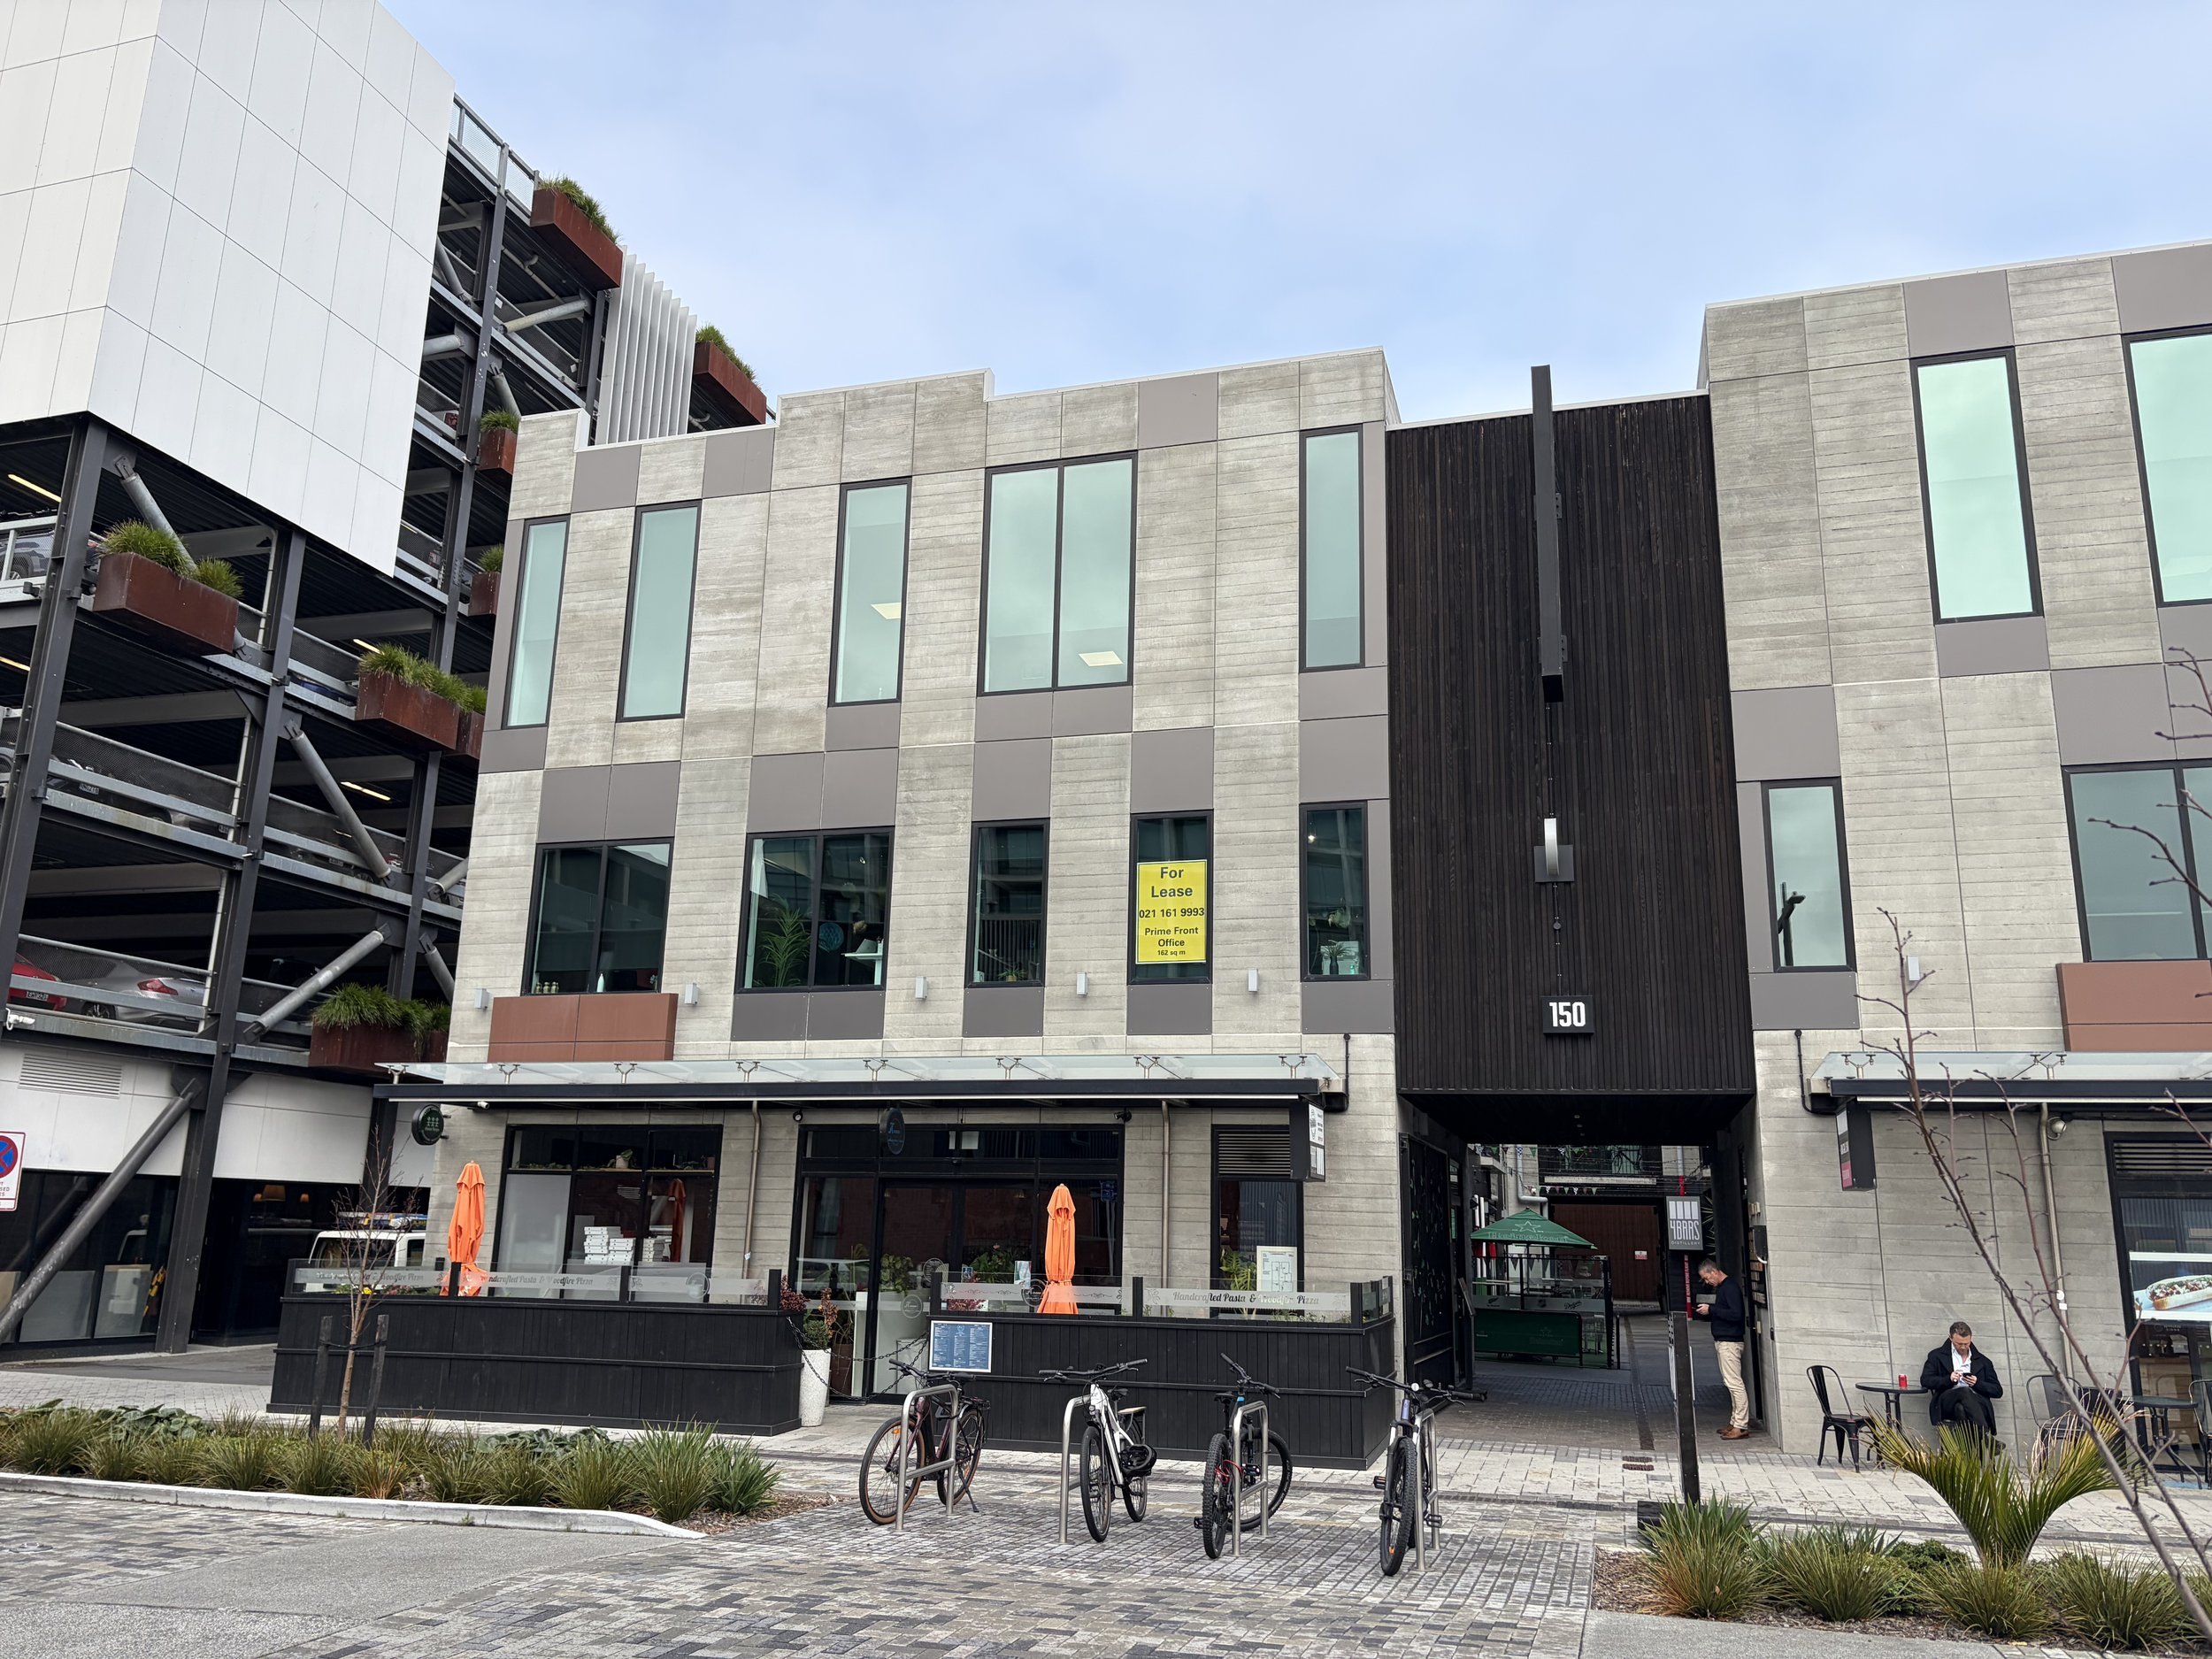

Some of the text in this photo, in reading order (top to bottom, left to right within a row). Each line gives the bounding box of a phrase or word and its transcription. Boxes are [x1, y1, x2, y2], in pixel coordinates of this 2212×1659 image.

[1160, 867, 1184, 879] For
[1150, 886, 1193, 897] Lease
[1139, 907, 1205, 918] 021 161 9993
[1157, 938, 1185, 947] Office
[1548, 1002, 1586, 1027] 150
[519, 1275, 537, 1284] Pasta
[1172, 1292, 1222, 1304] Handcrafted
[1223, 1293, 1246, 1302] Pasta
[1249, 1294, 1257, 1303] &
[1296, 1294, 1318, 1305] Pizza
